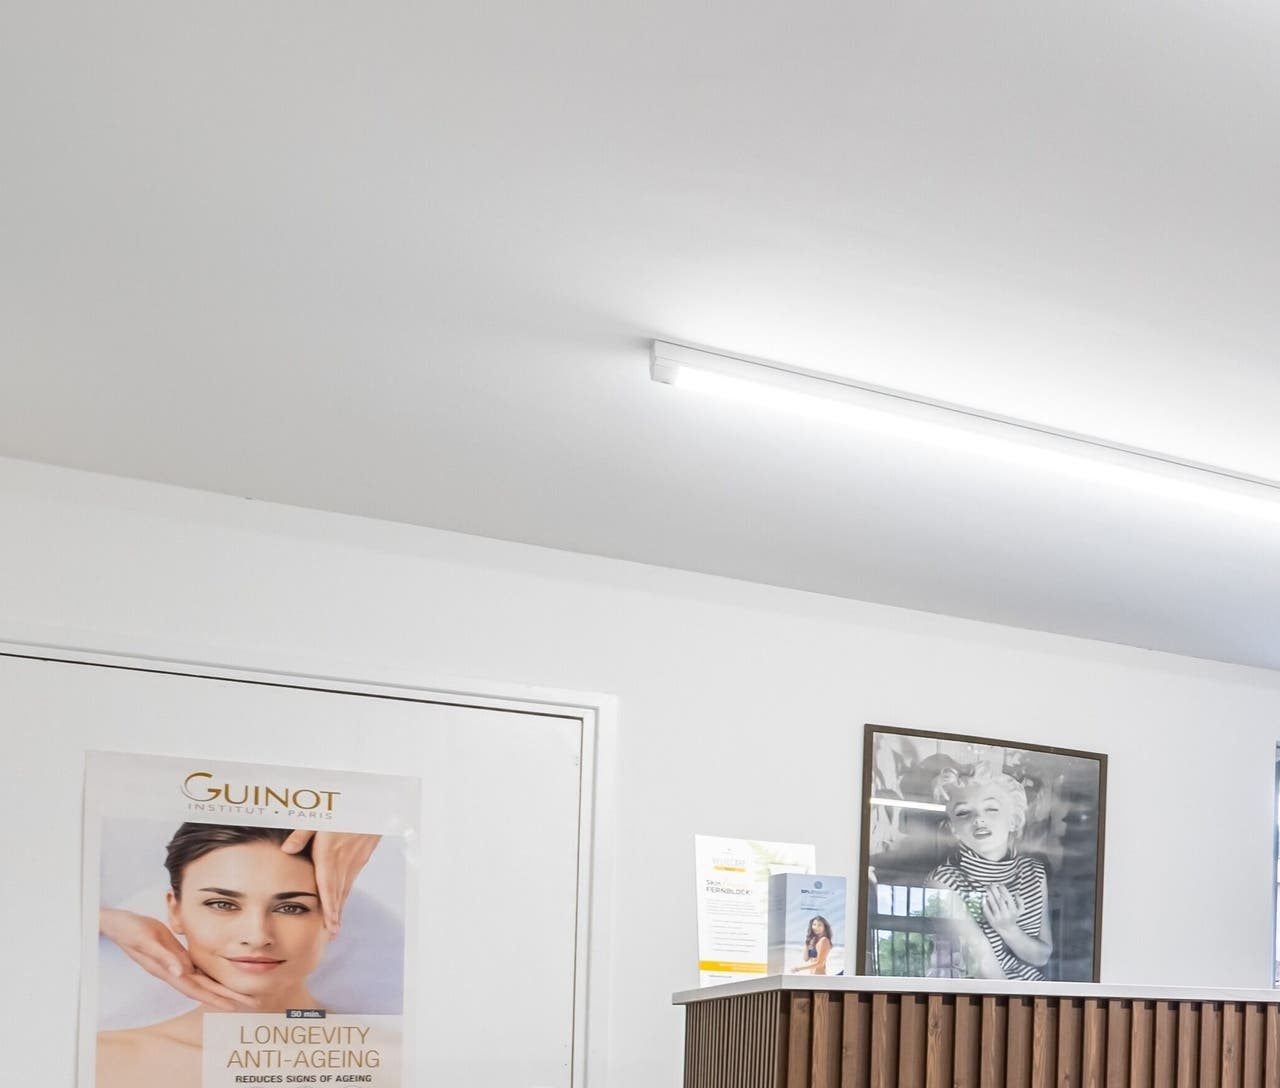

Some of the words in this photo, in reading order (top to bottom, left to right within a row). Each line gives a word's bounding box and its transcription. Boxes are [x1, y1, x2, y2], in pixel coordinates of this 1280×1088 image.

[180, 772, 342, 811] GUINOT
[188, 802, 265, 815] INSTITUT
[288, 810, 333, 820] PARIS
[290, 1010, 302, 1018] 50
[240, 1025, 371, 1045] LONGEVITY
[226, 1049, 381, 1069] ANTI-AGEING
[235, 1075, 283, 1083] REDUCES
[286, 1075, 317, 1083] SIGNS
[335, 1074, 372, 1083] AGEING
